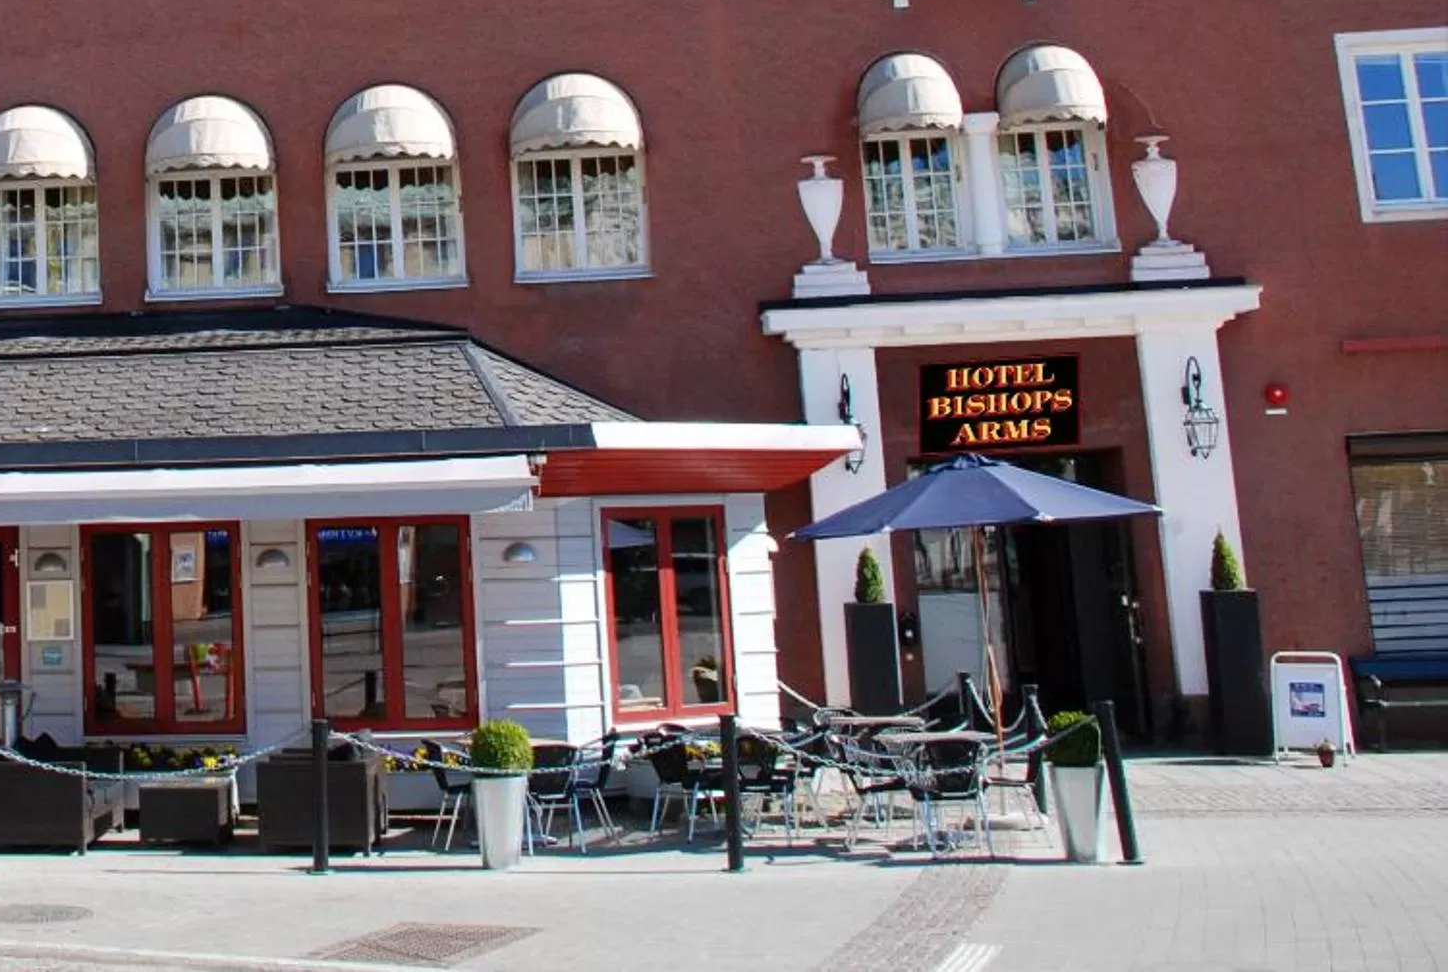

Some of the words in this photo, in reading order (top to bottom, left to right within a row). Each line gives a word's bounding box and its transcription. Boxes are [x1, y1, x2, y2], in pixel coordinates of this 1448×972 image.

[945, 363, 1055, 391] HOTEL
[927, 389, 1073, 420] BISHOPS
[950, 418, 1052, 446] ARMS
